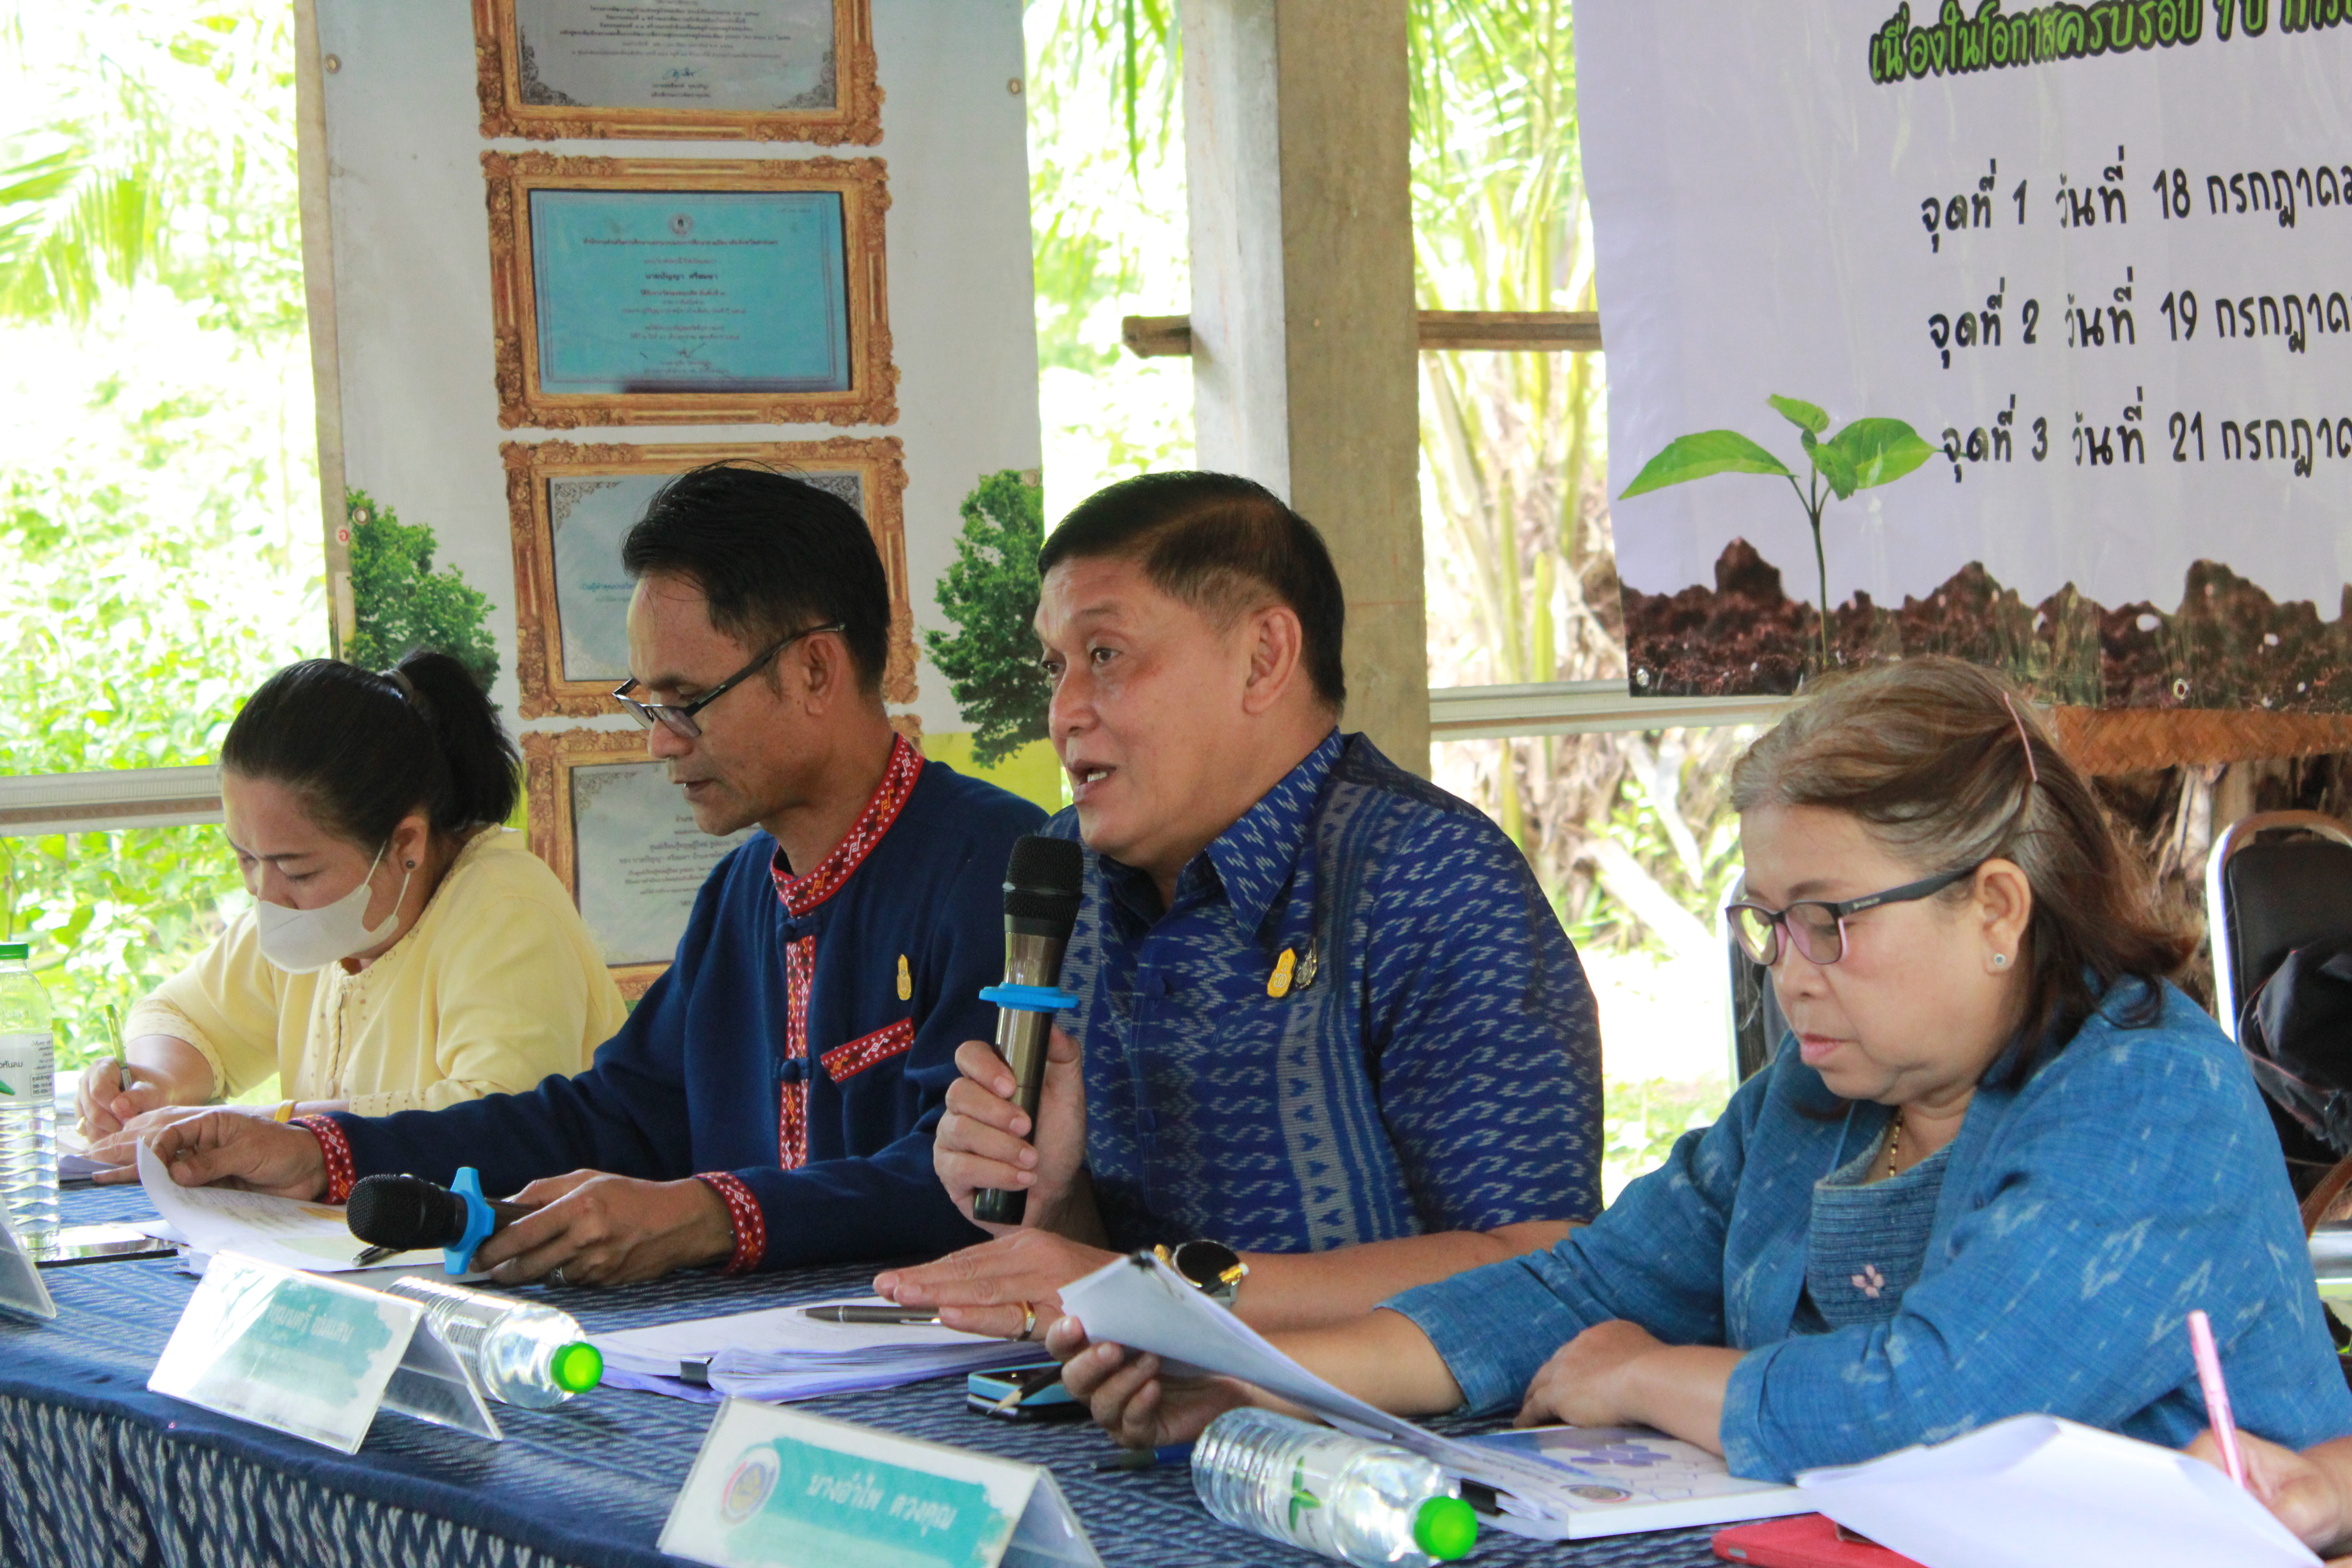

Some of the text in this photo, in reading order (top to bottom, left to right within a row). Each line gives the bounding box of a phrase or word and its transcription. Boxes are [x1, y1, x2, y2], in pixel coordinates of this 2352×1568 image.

[1921, 158, 1996, 253] จุดที่
[2013, 179, 2027, 225] 1
[2055, 145, 2127, 228] วันที่
[2153, 168, 2190, 220] 18
[1928, 266, 2352, 369] จุดที่ 2 วันที่ 19 กรกฎาค
[1940, 394, 2016, 483] จุดที่
[2031, 417, 2048, 461] 3
[2071, 386, 2145, 467] วันที่
[2168, 411, 2205, 463] 21
